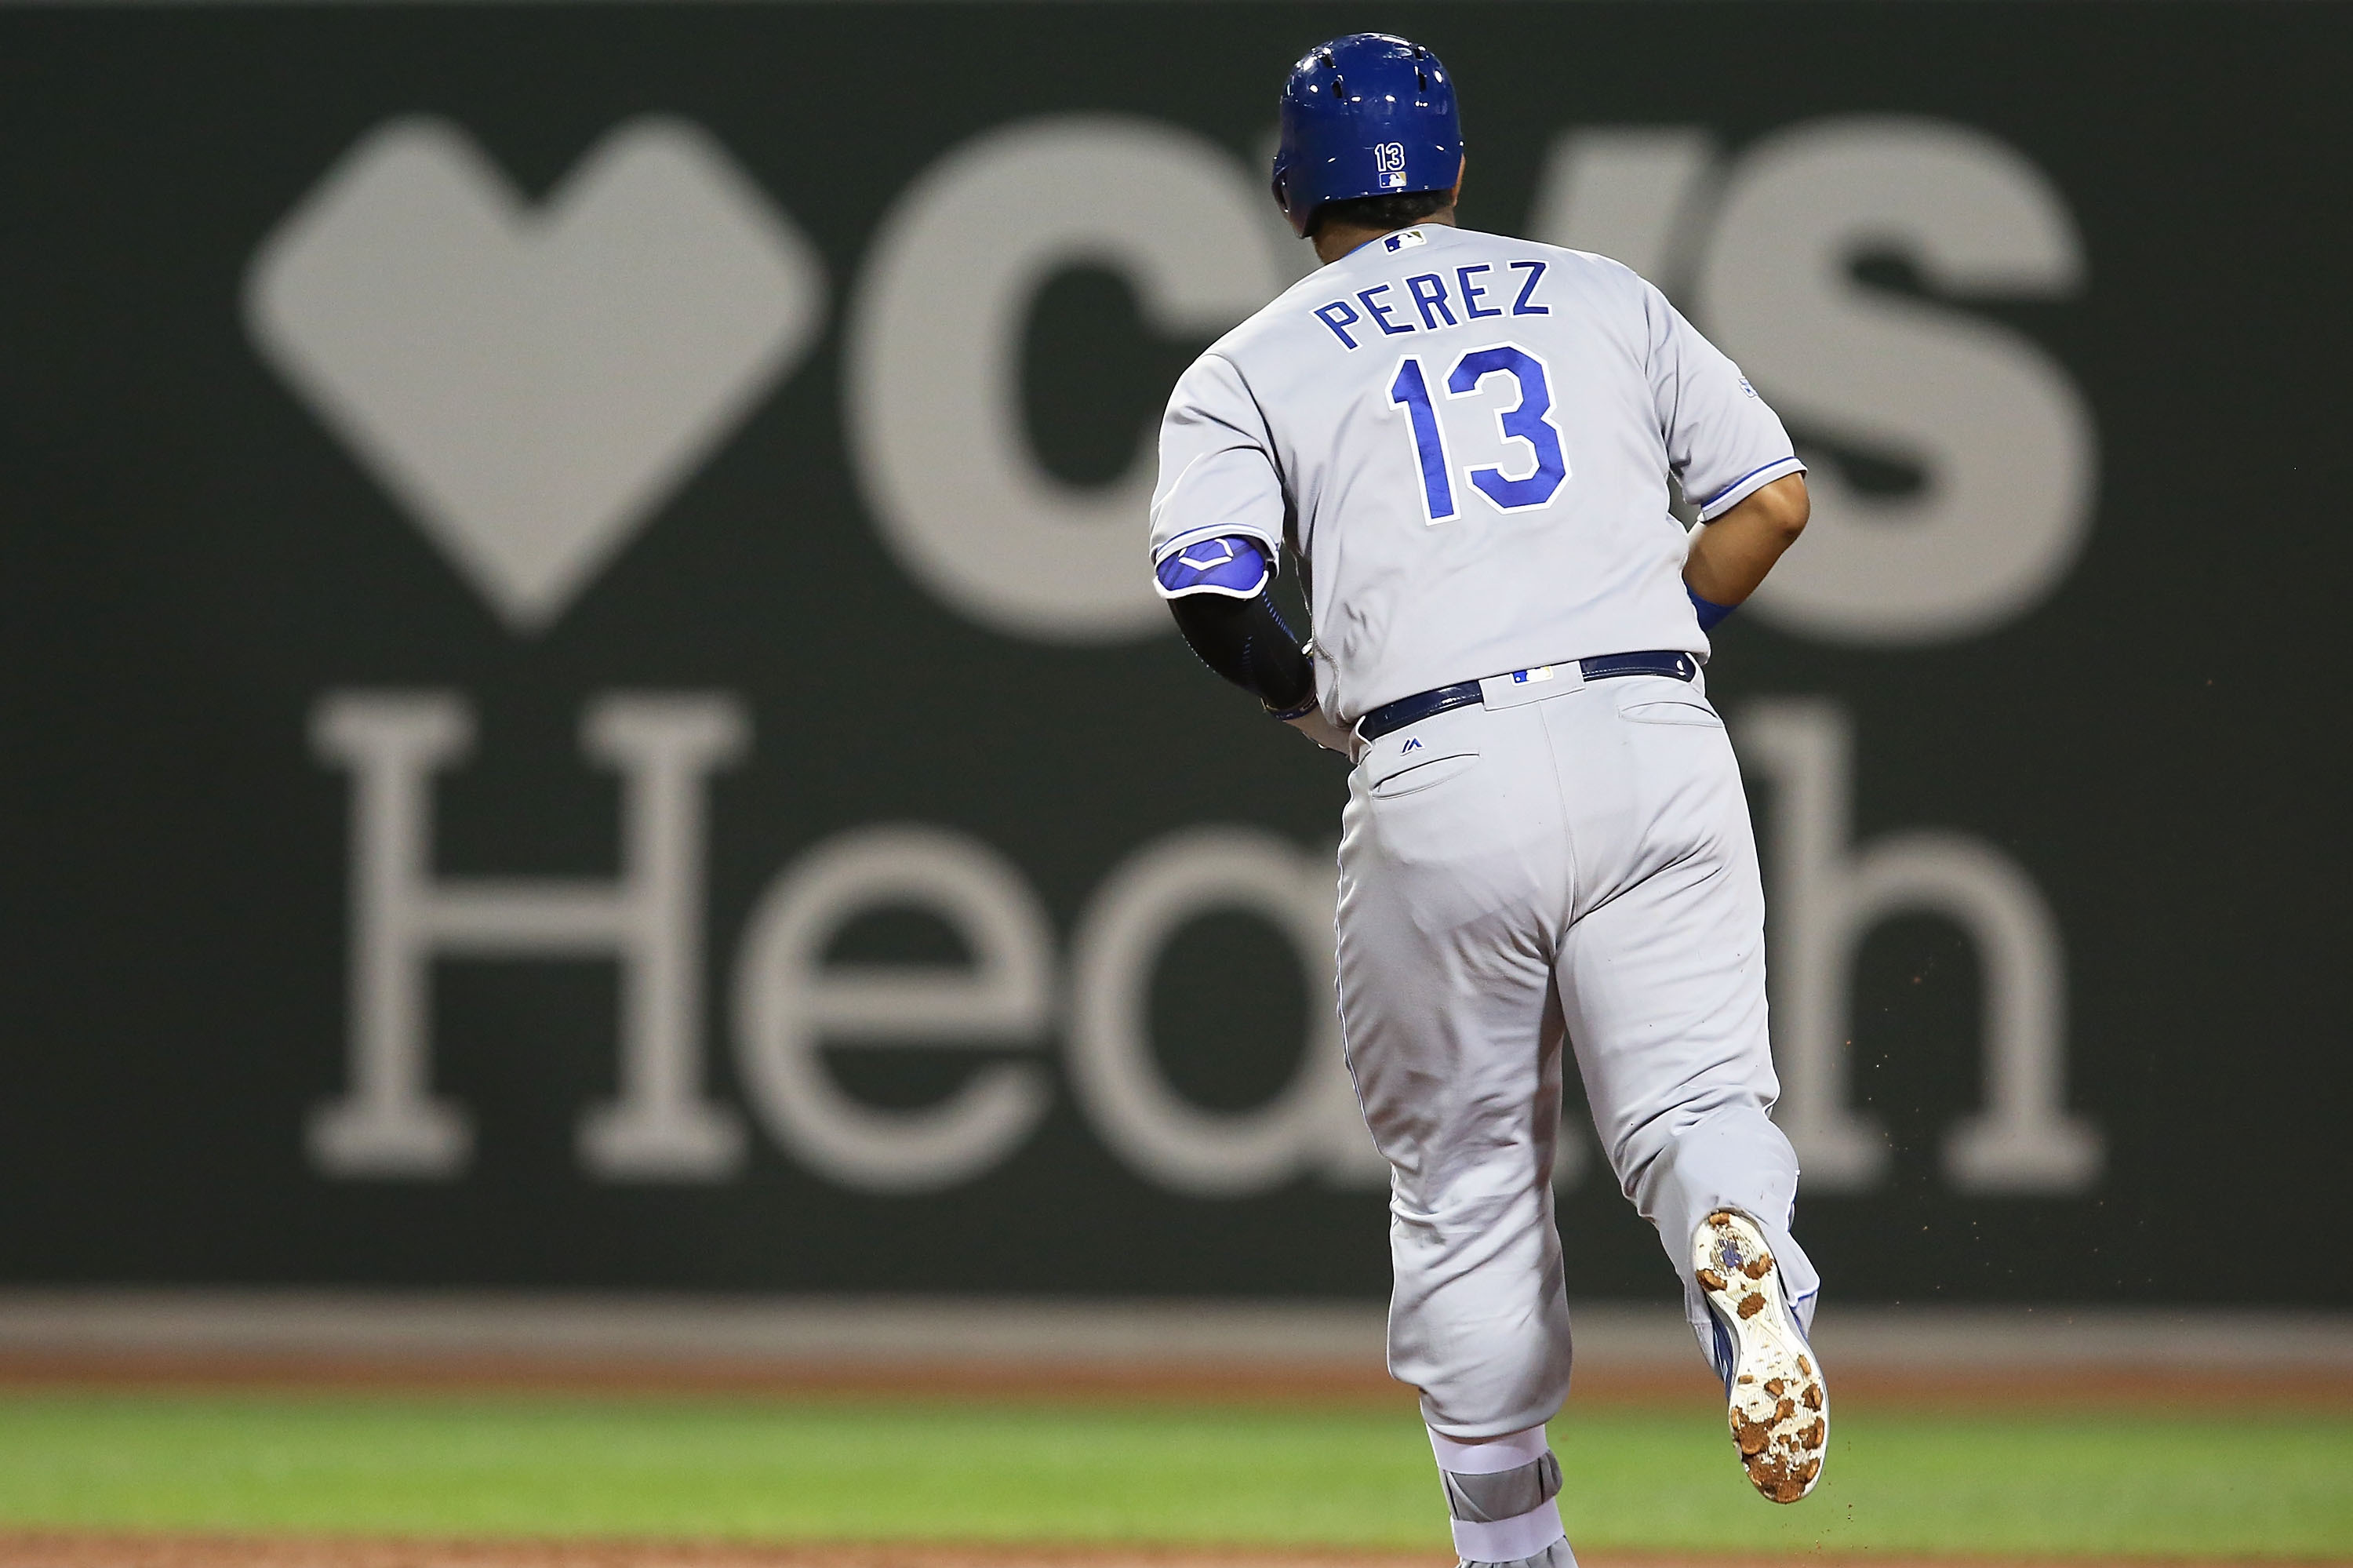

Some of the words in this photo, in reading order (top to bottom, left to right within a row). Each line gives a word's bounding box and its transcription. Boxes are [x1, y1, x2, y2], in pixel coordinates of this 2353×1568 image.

[1375, 142, 1405, 172] 13
[847, 118, 2091, 643] CS
[1311, 260, 1551, 352] PEREZ
[1385, 341, 1572, 526] 13
[309, 693, 2102, 1194] Heah
